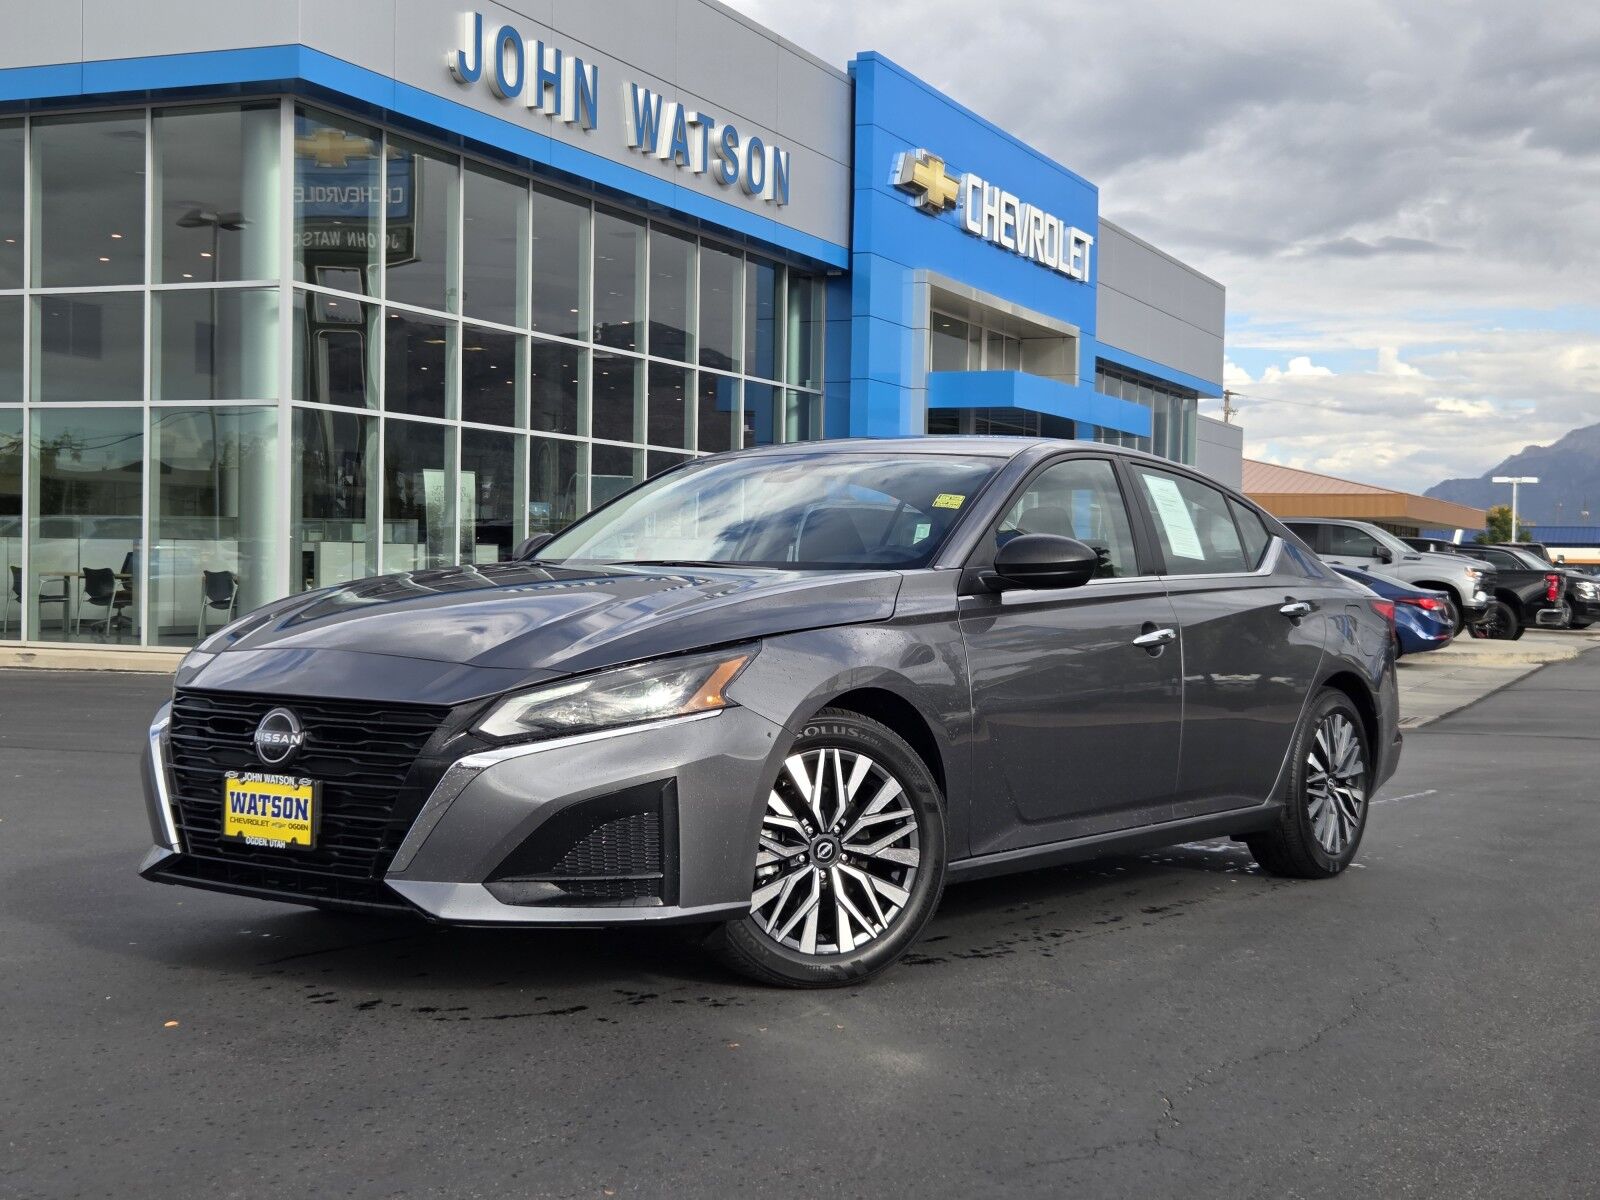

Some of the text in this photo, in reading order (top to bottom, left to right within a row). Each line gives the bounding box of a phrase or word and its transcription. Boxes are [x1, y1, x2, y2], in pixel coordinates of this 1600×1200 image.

[449, 11, 790, 205] JOHN WATSON
[960, 172, 1094, 283] CHEVROLET
[256, 732, 303, 744] NISSAN
[243, 772, 295, 786] JOHN WATSON
[229, 791, 309, 821] WATSON
[229, 816, 309, 831] CHEVROLET OGDEN
[269, 838, 286, 849] UTAH
